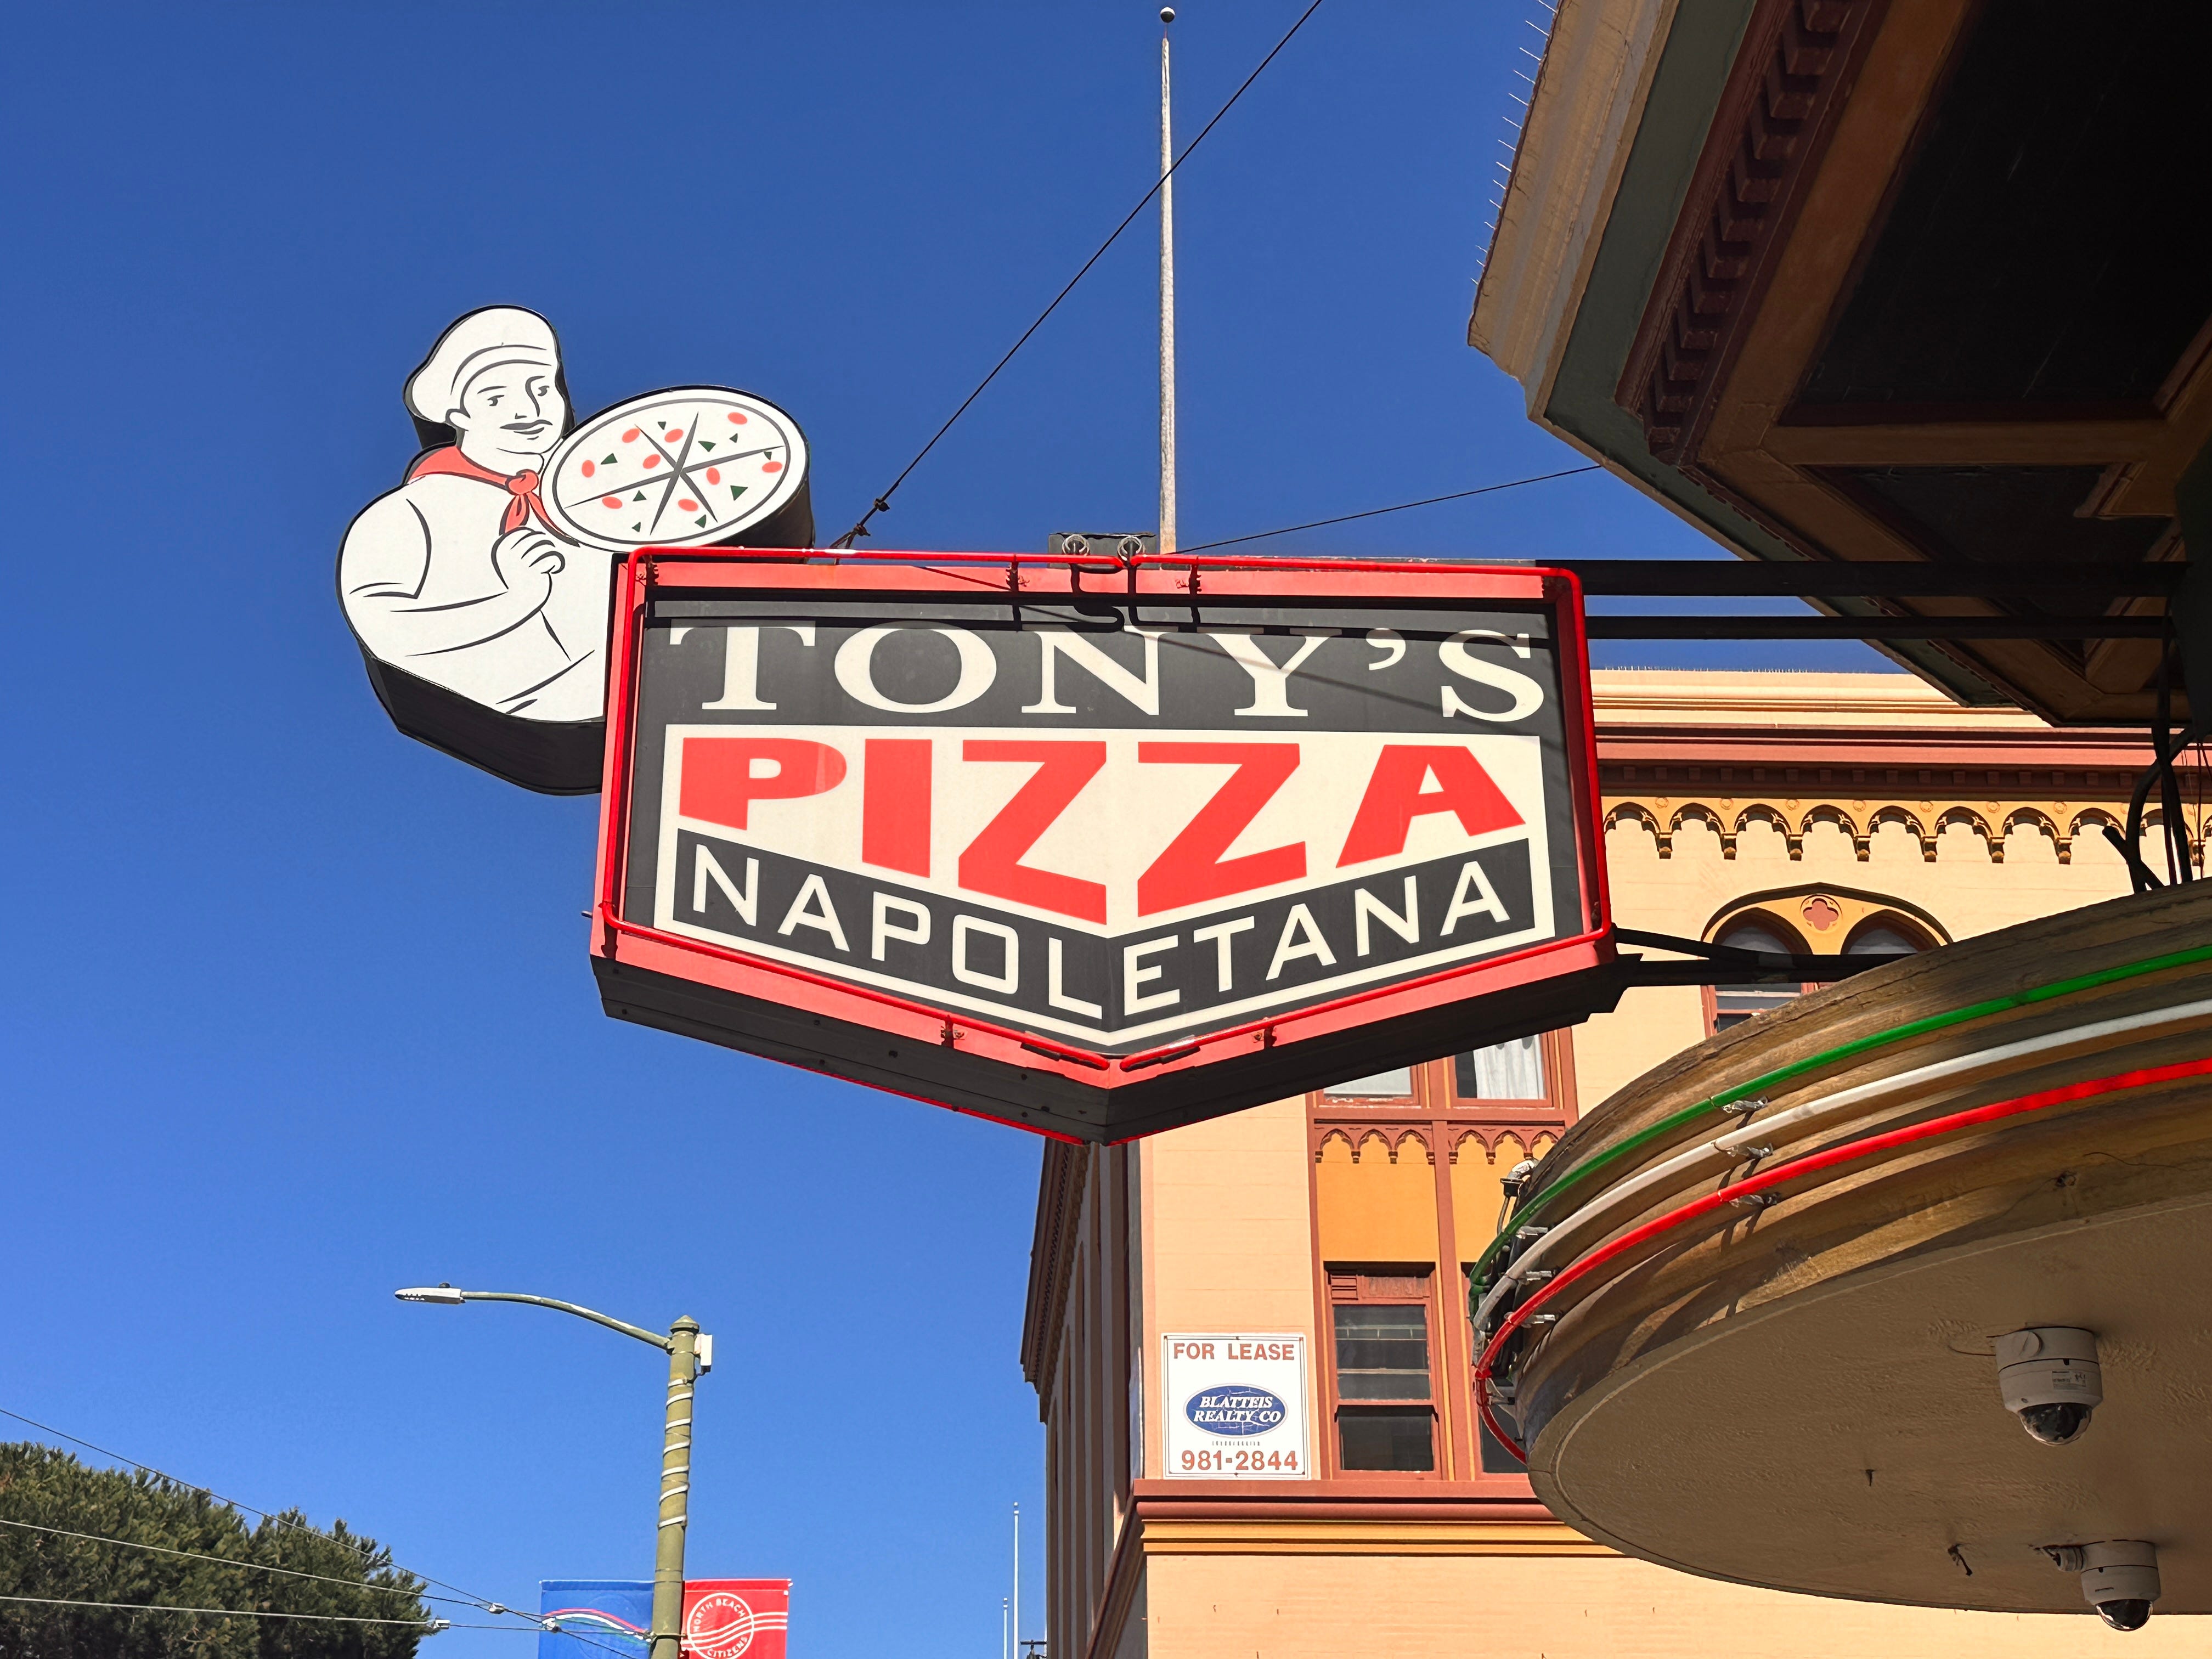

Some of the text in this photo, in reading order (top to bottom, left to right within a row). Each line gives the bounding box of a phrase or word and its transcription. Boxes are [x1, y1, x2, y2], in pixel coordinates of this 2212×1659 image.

[669, 619, 1544, 722] TONY'S
[680, 738, 1526, 924] PIZZA
[693, 844, 1510, 1019] NAPOLETANA
[1173, 1342, 1295, 1361] FOR LEASE
[1200, 1396, 1273, 1408] BLATTEIS
[1194, 1410, 1282, 1423] REALTY CO
[1181, 1450, 1298, 1471] 981-2844
[693, 1598, 745, 1633] NORTH BEACH
[707, 1637, 748, 1658] CITIZENS
